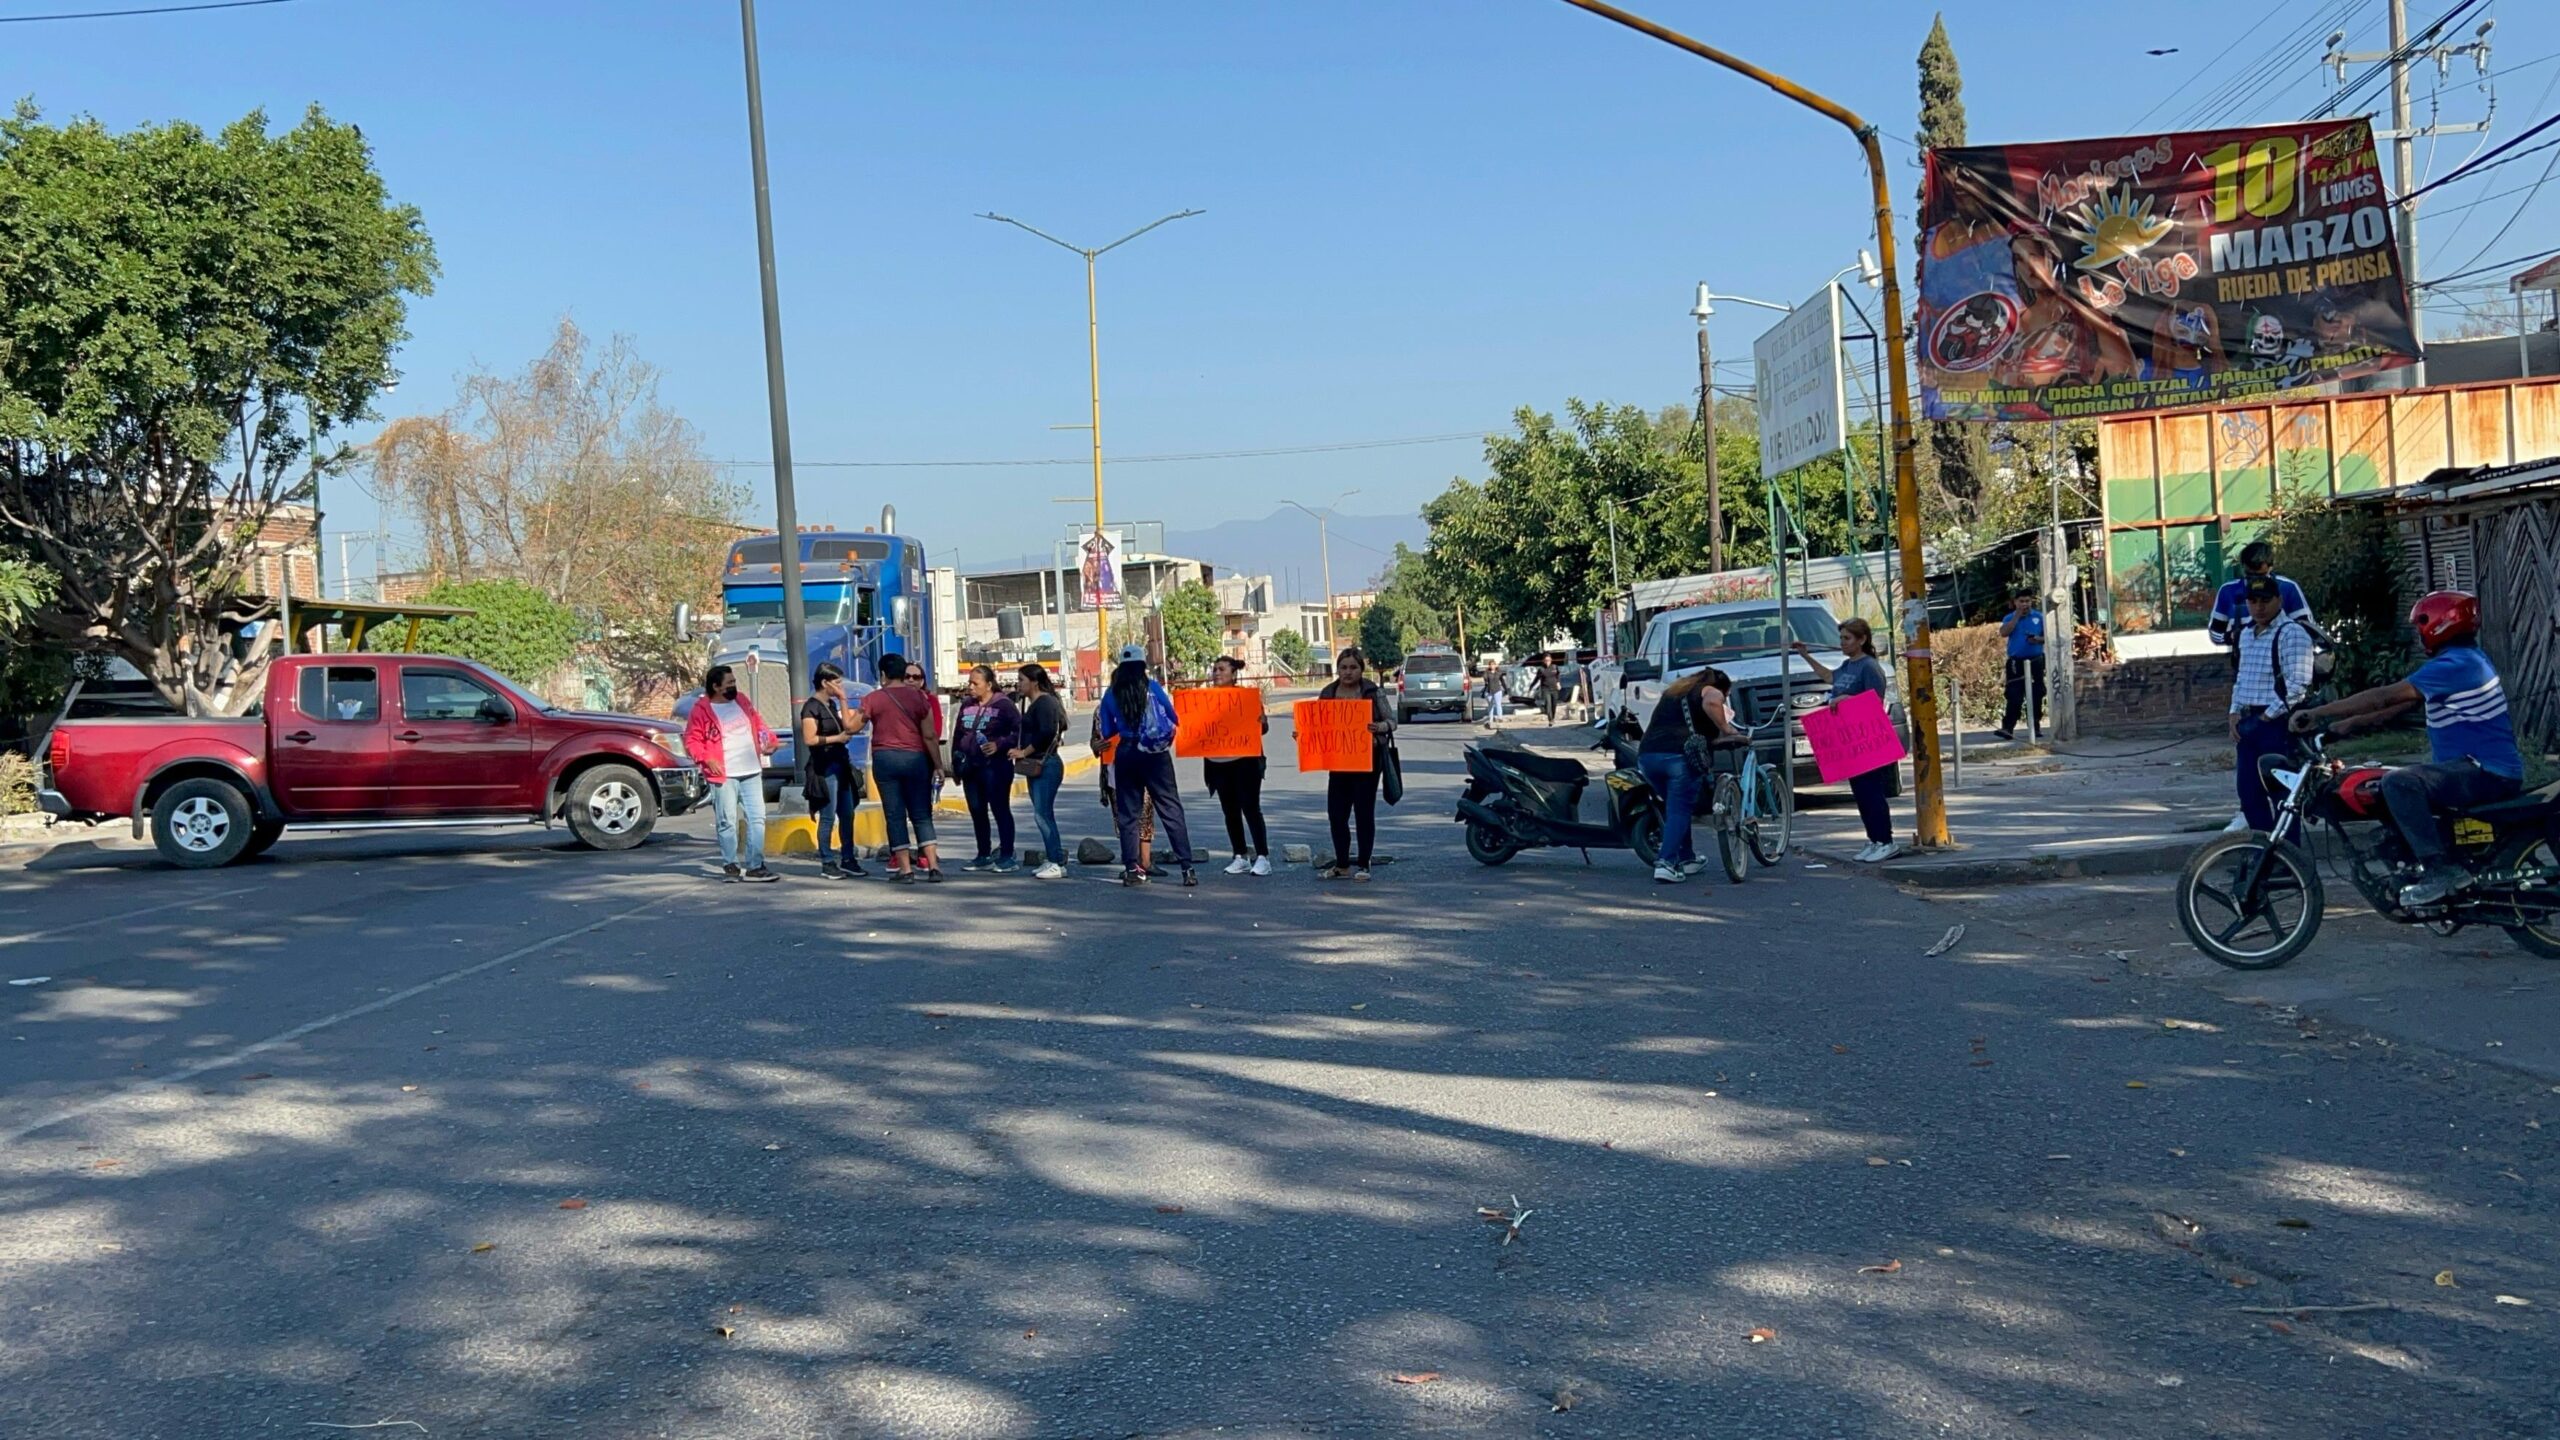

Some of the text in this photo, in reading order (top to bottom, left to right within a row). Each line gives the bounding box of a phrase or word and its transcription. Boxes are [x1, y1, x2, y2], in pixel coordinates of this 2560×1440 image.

[2036, 137, 2173, 222] Mariscos
[2202, 136, 2299, 222] 10
[2319, 174, 2377, 207] LUNES
[2210, 206, 2387, 273] MARZO
[2077, 274, 2127, 309] La
[2217, 251, 2393, 303] RUEDA DE PRENSA
[1941, 390, 1971, 404] BIG
[1978, 389, 2029, 404] MAMI
[2048, 384, 2106, 401] DIOSA
[2111, 378, 2192, 397] QUETZAL
[2210, 364, 2291, 387] PARKITA
[2053, 397, 2135, 417] MORGAN
[2155, 389, 2222, 407] NATALY
[2228, 382, 2276, 397] STAR
